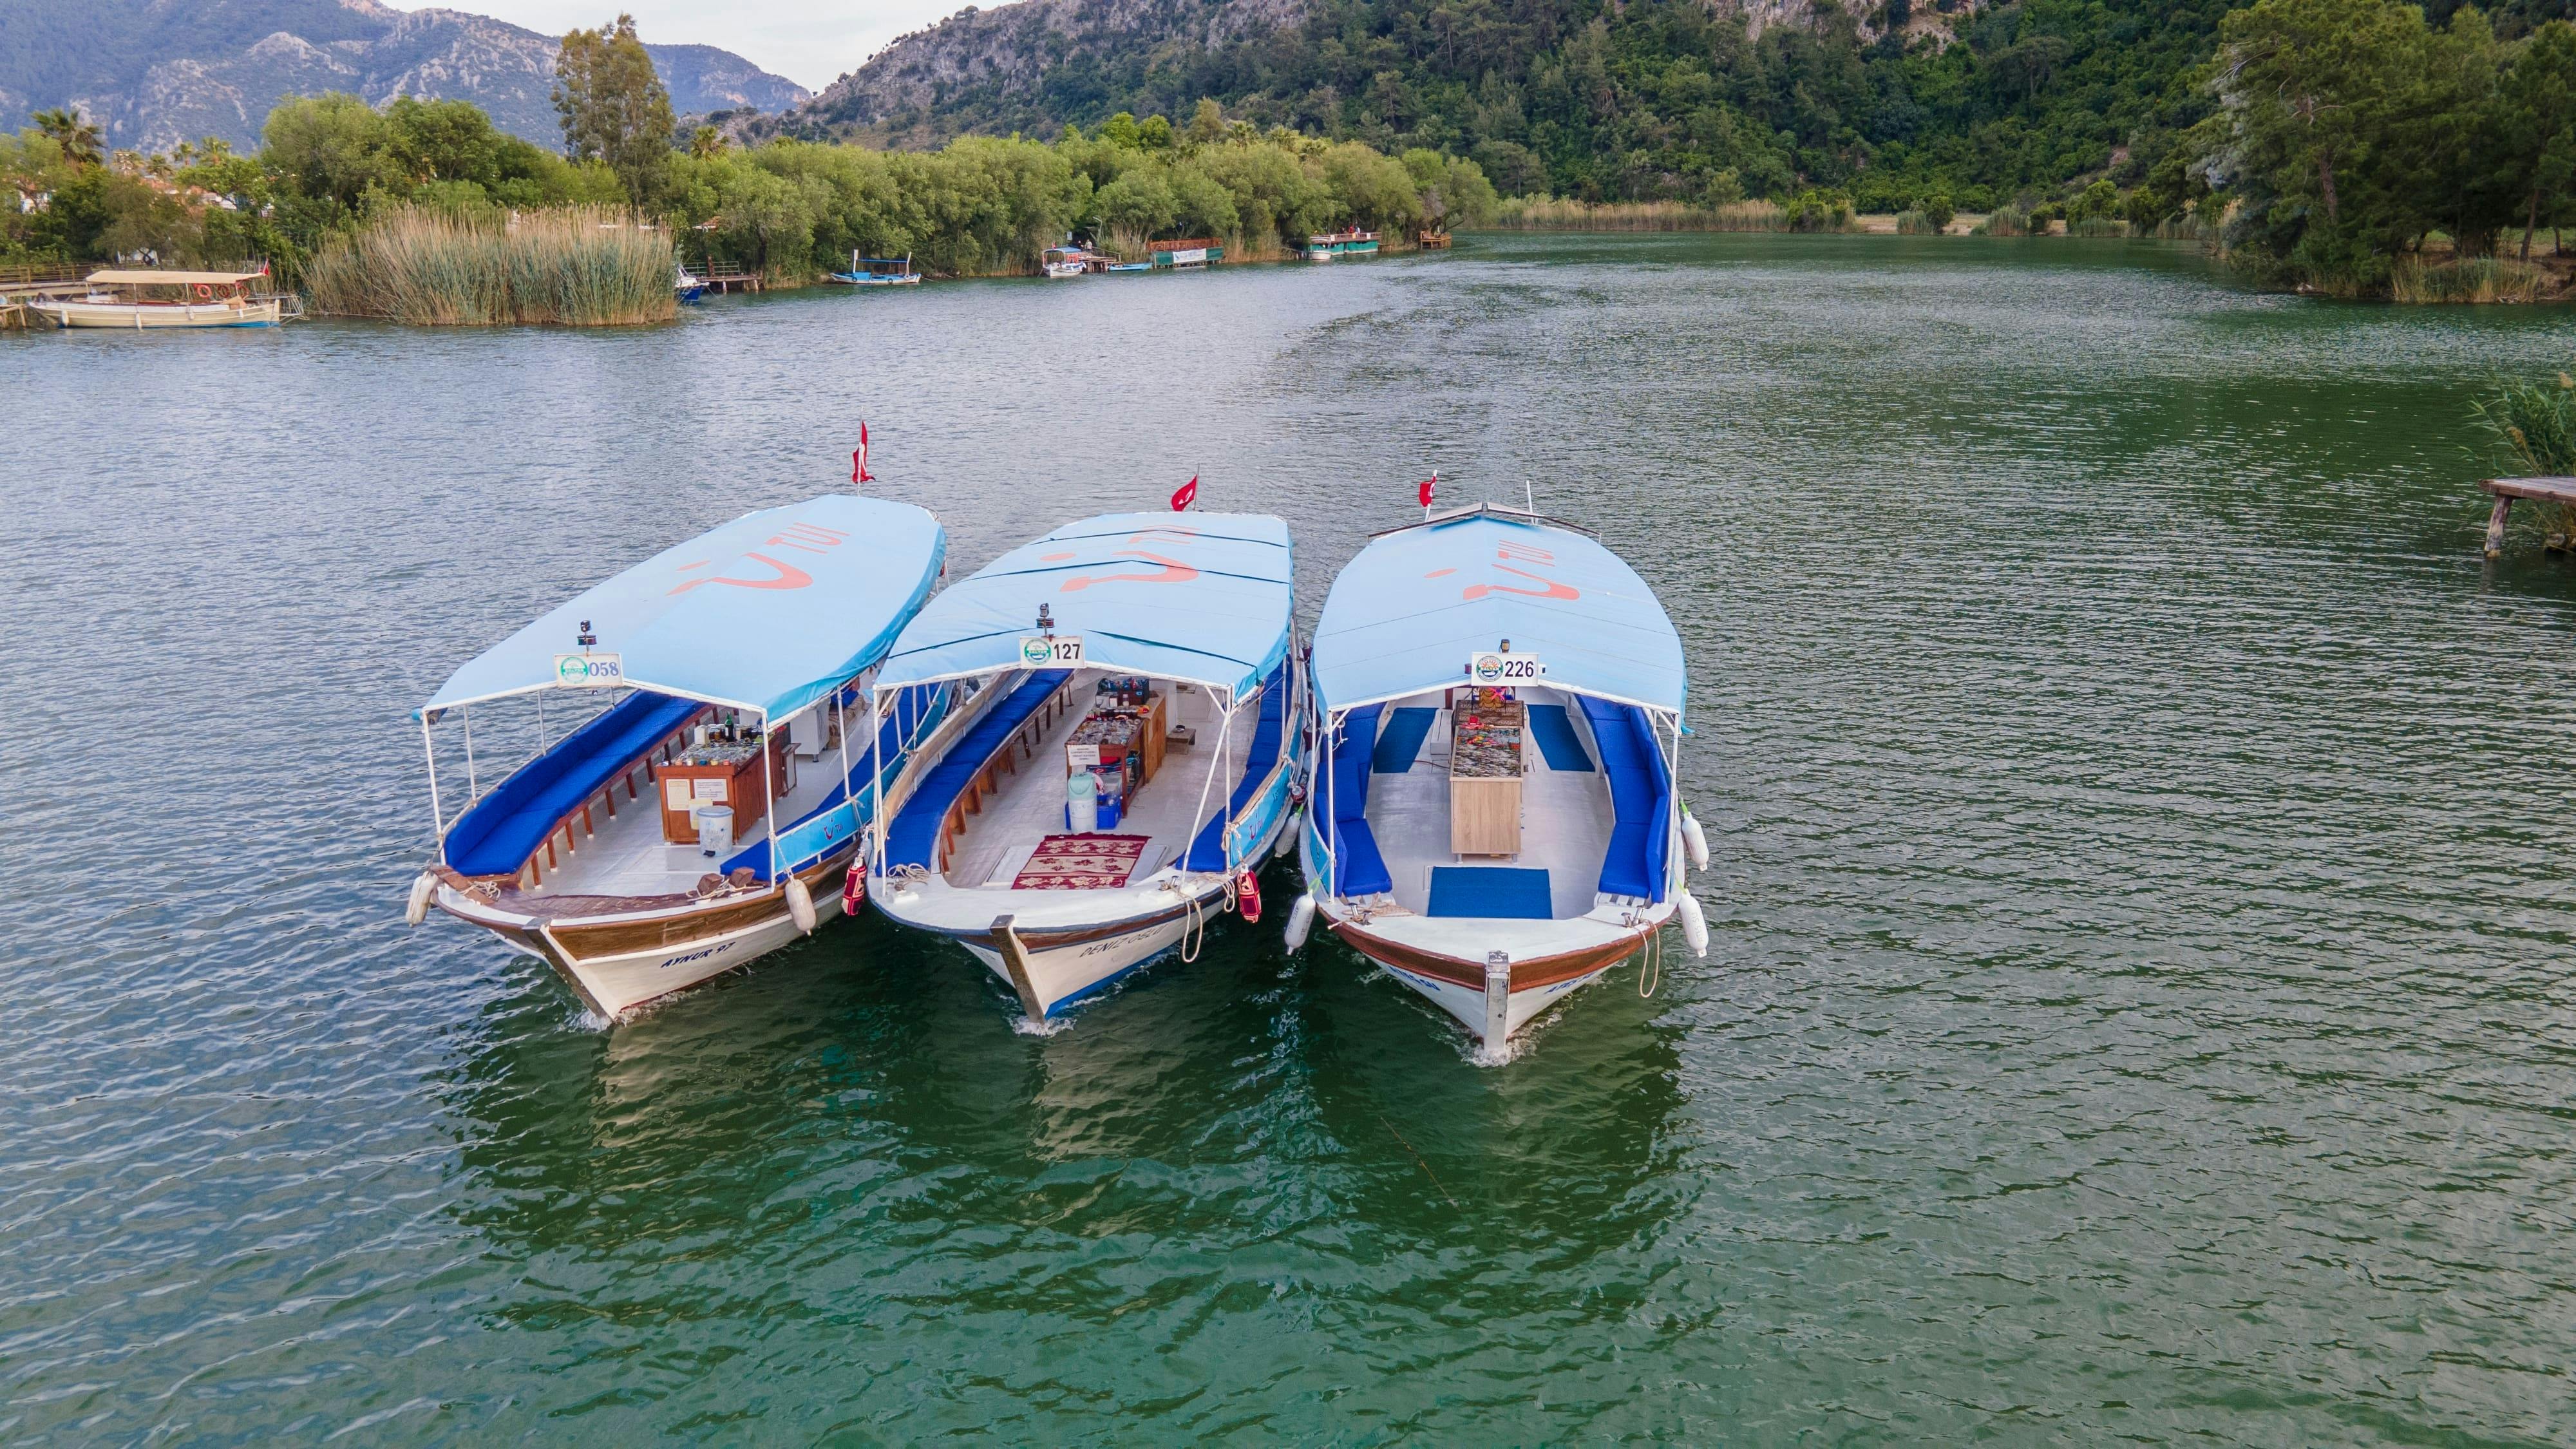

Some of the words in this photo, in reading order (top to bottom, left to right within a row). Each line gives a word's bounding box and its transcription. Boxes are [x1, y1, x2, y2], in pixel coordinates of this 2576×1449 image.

[763, 522, 850, 554] TUI
[1498, 539, 1555, 567] TUI
[1054, 643, 1081, 660] 127
[588, 661, 619, 677] 058
[1504, 660, 1534, 677] 226
[661, 949, 714, 968] AYNUR
[716, 942, 736, 954] 97
